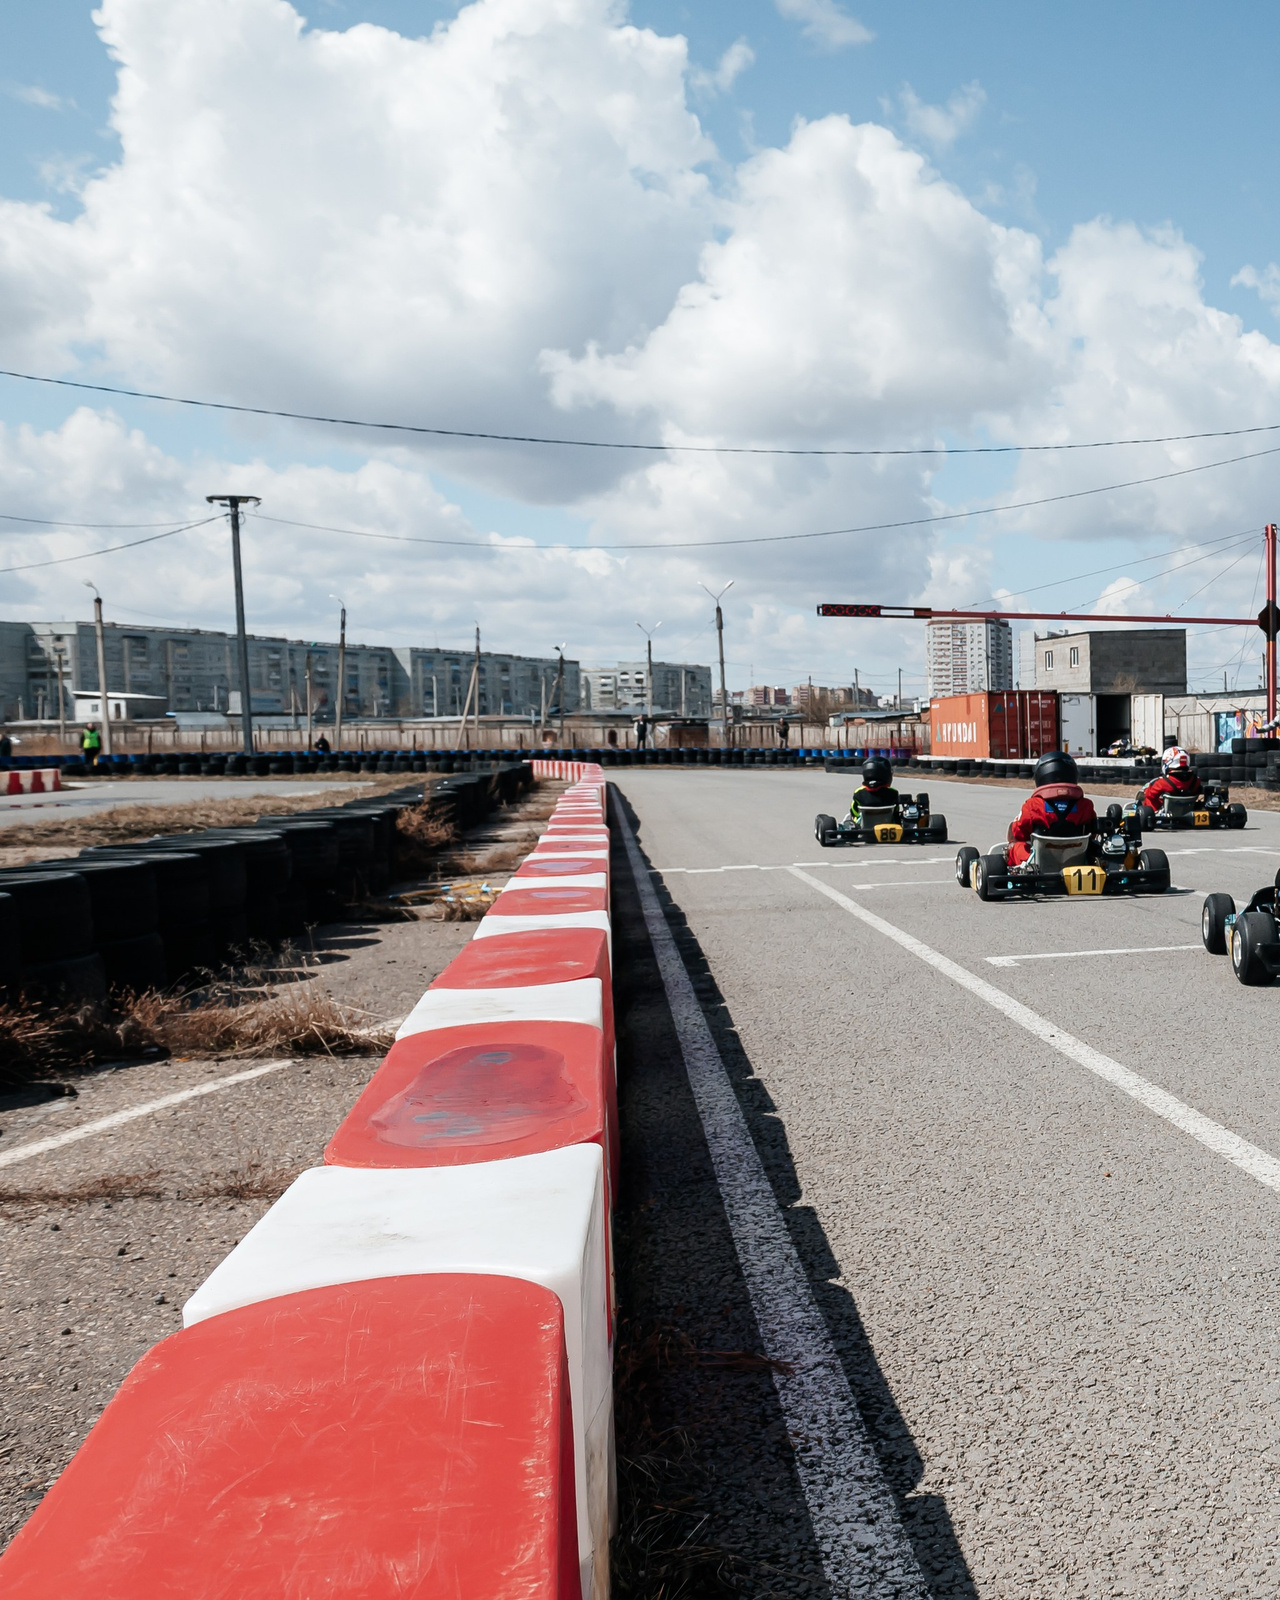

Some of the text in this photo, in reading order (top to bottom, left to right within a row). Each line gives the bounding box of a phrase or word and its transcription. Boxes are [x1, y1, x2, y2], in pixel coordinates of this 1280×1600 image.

[942, 722, 977, 743] HYUNDAI
[1195, 814, 1208, 823] 13
[881, 828, 897, 841] 86
[1073, 869, 1096, 891] 11
